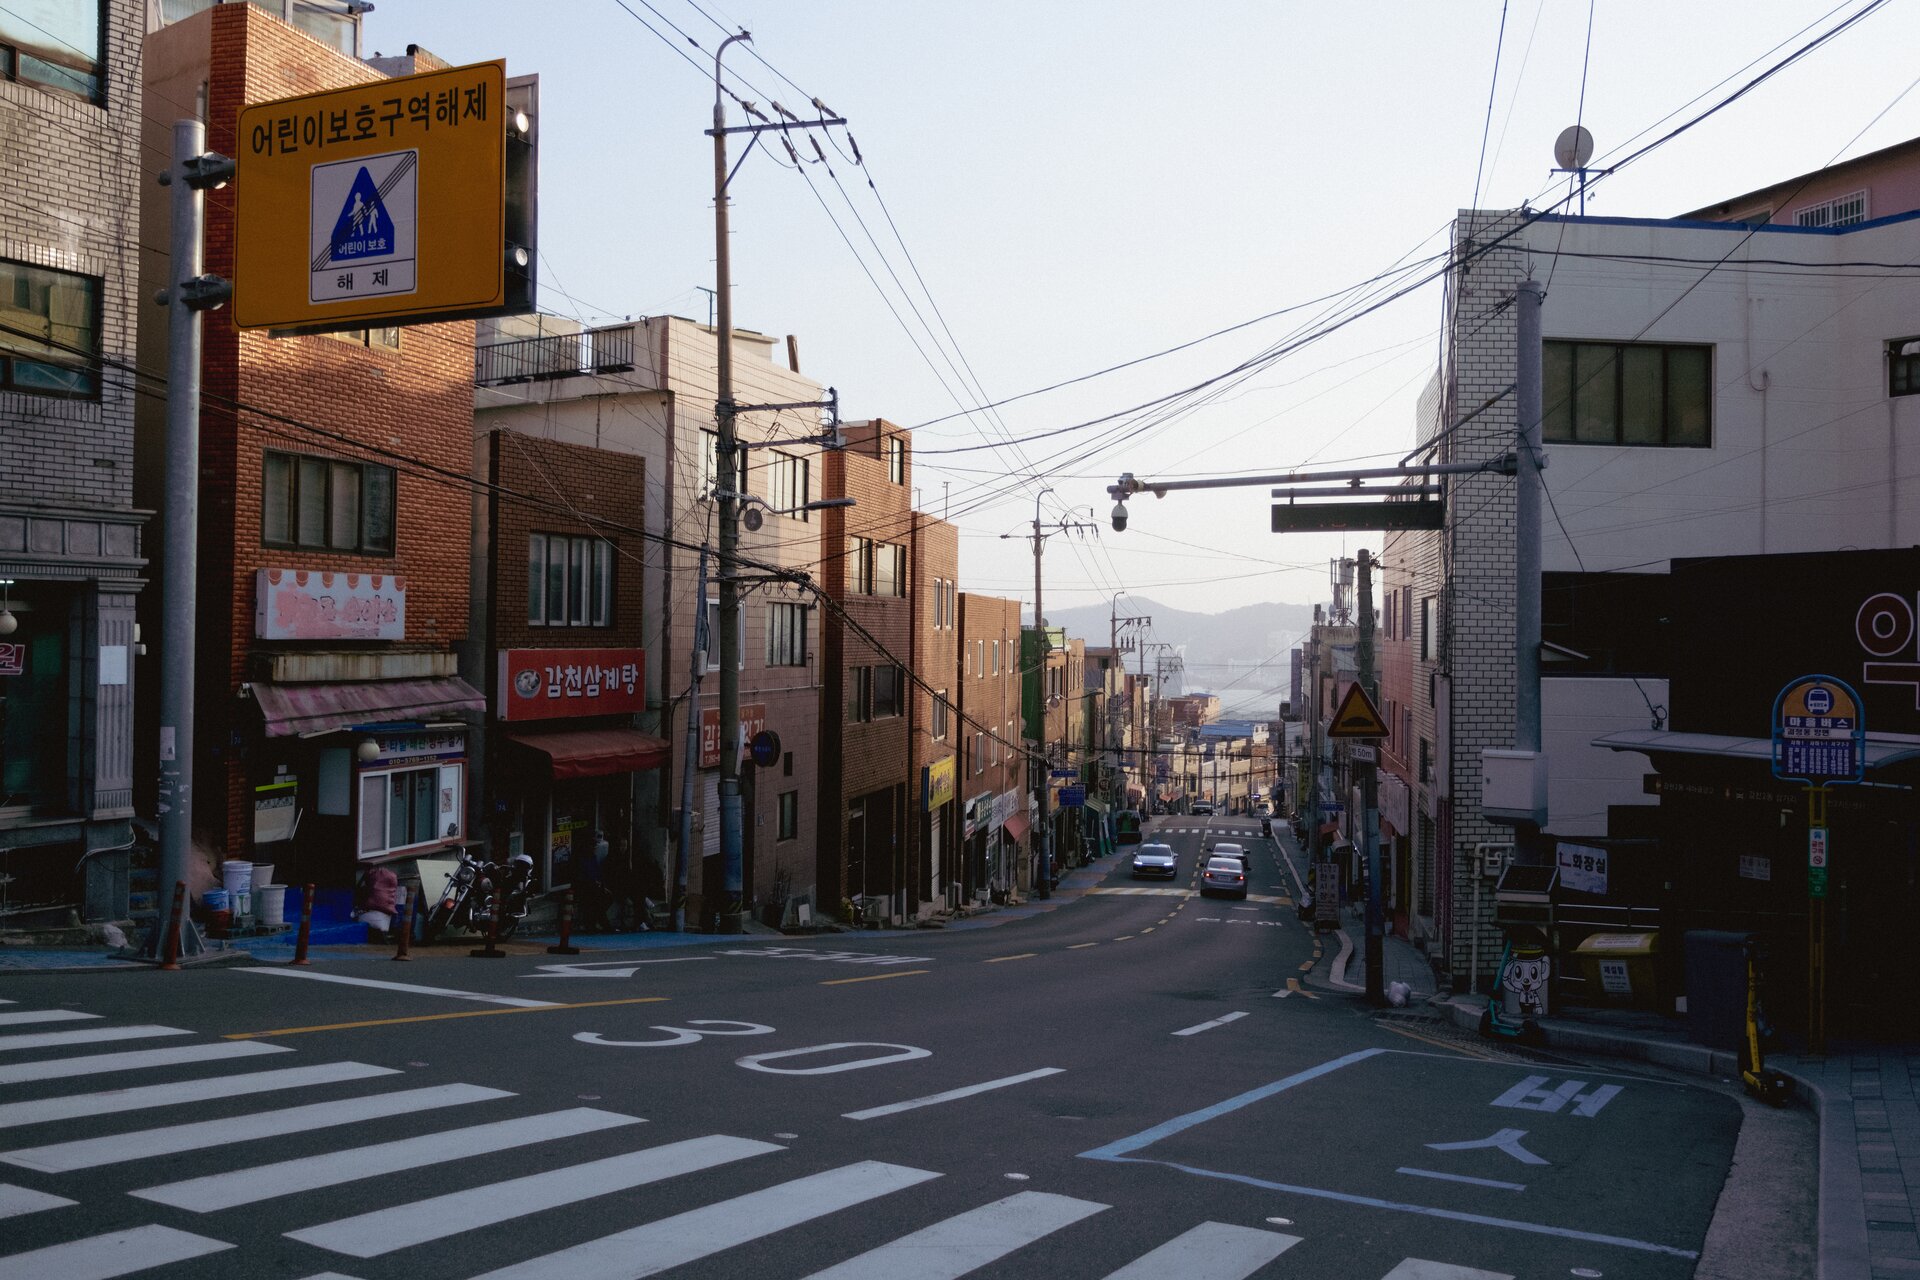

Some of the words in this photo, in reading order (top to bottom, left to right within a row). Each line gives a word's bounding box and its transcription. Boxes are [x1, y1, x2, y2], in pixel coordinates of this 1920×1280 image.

[252, 82, 487, 156] 어린이보호구역해제
[338, 240, 366, 255] 어린이
[367, 237, 387, 251] 보호
[545, 663, 640, 698] 감천삼계탕
[1572, 853, 1606, 874] 화장실
[572, 1019, 934, 1076] 30
